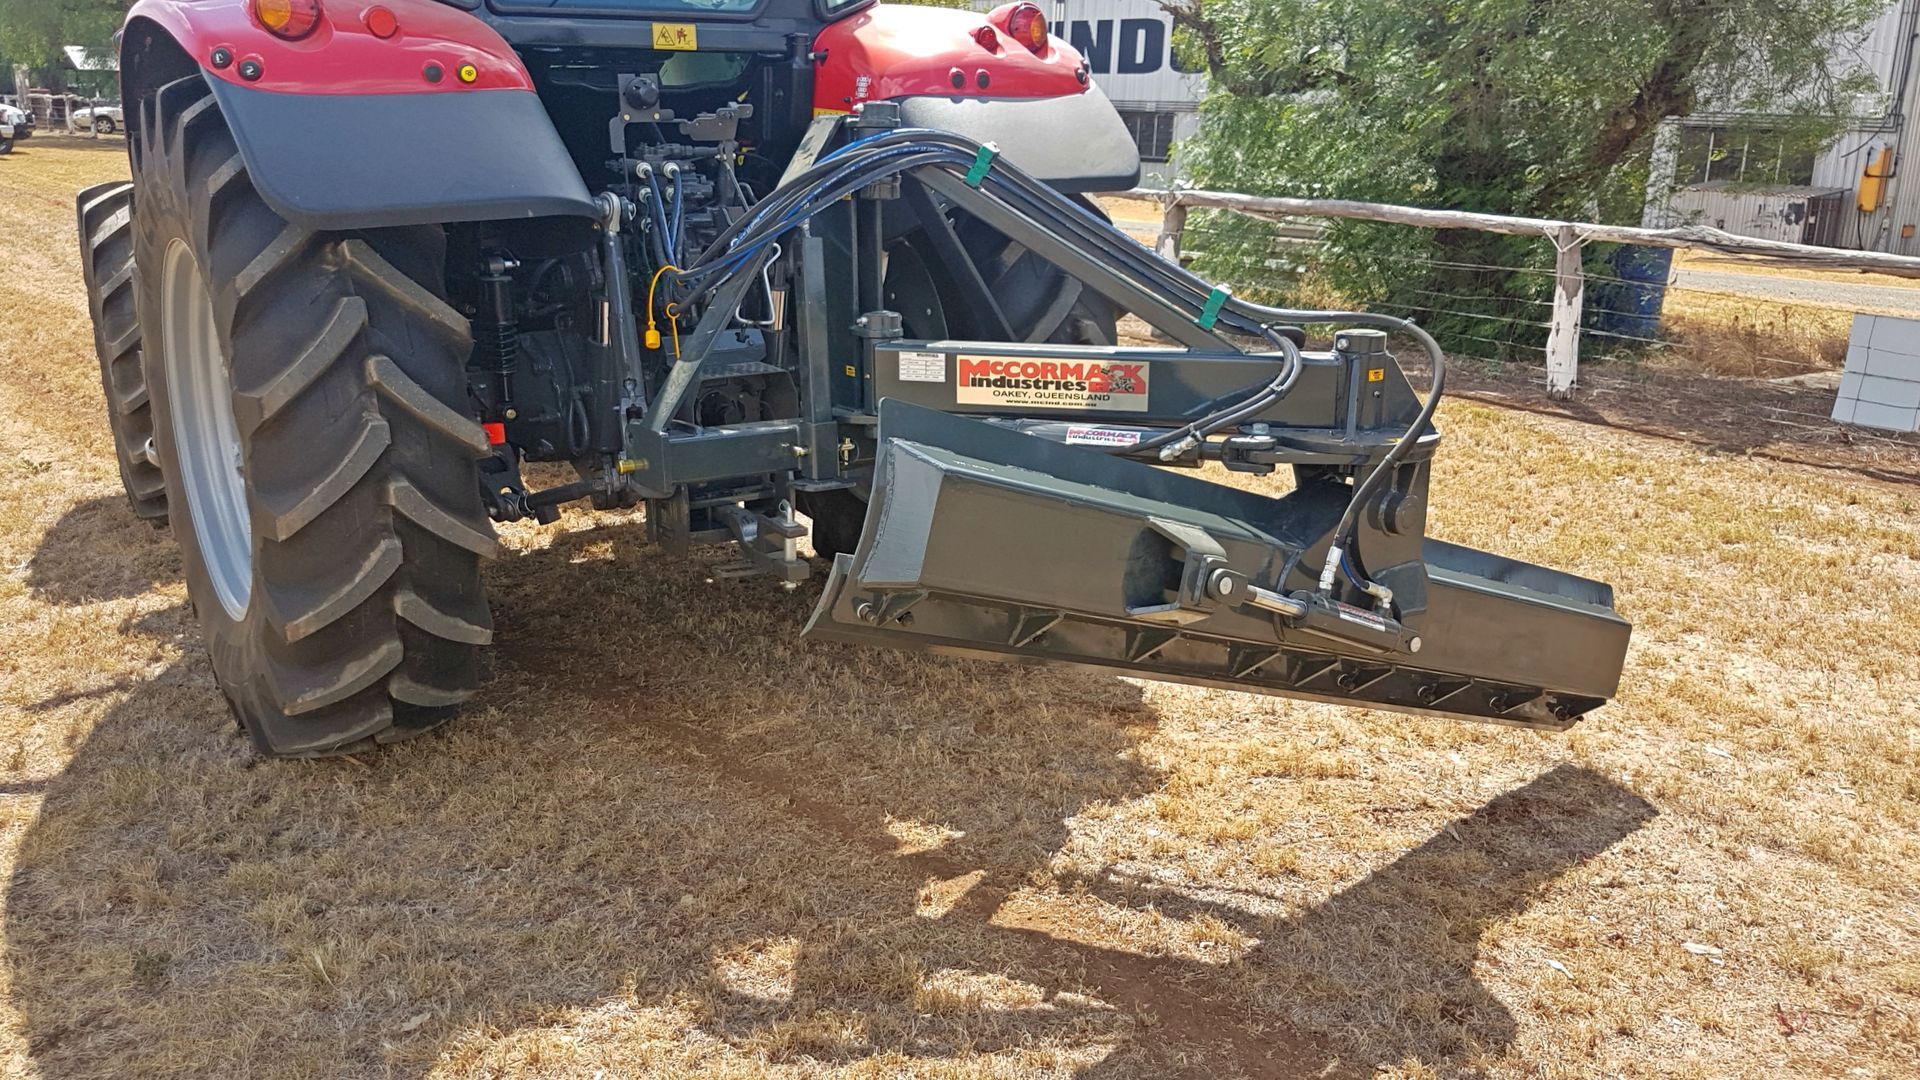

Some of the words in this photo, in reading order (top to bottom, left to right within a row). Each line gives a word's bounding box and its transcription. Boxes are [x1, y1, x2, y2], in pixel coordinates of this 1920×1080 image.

[971, 375, 1087, 392] industries
[992, 390, 1031, 399] OAKEY,
[1035, 391, 1111, 401] QUEENSLAND
